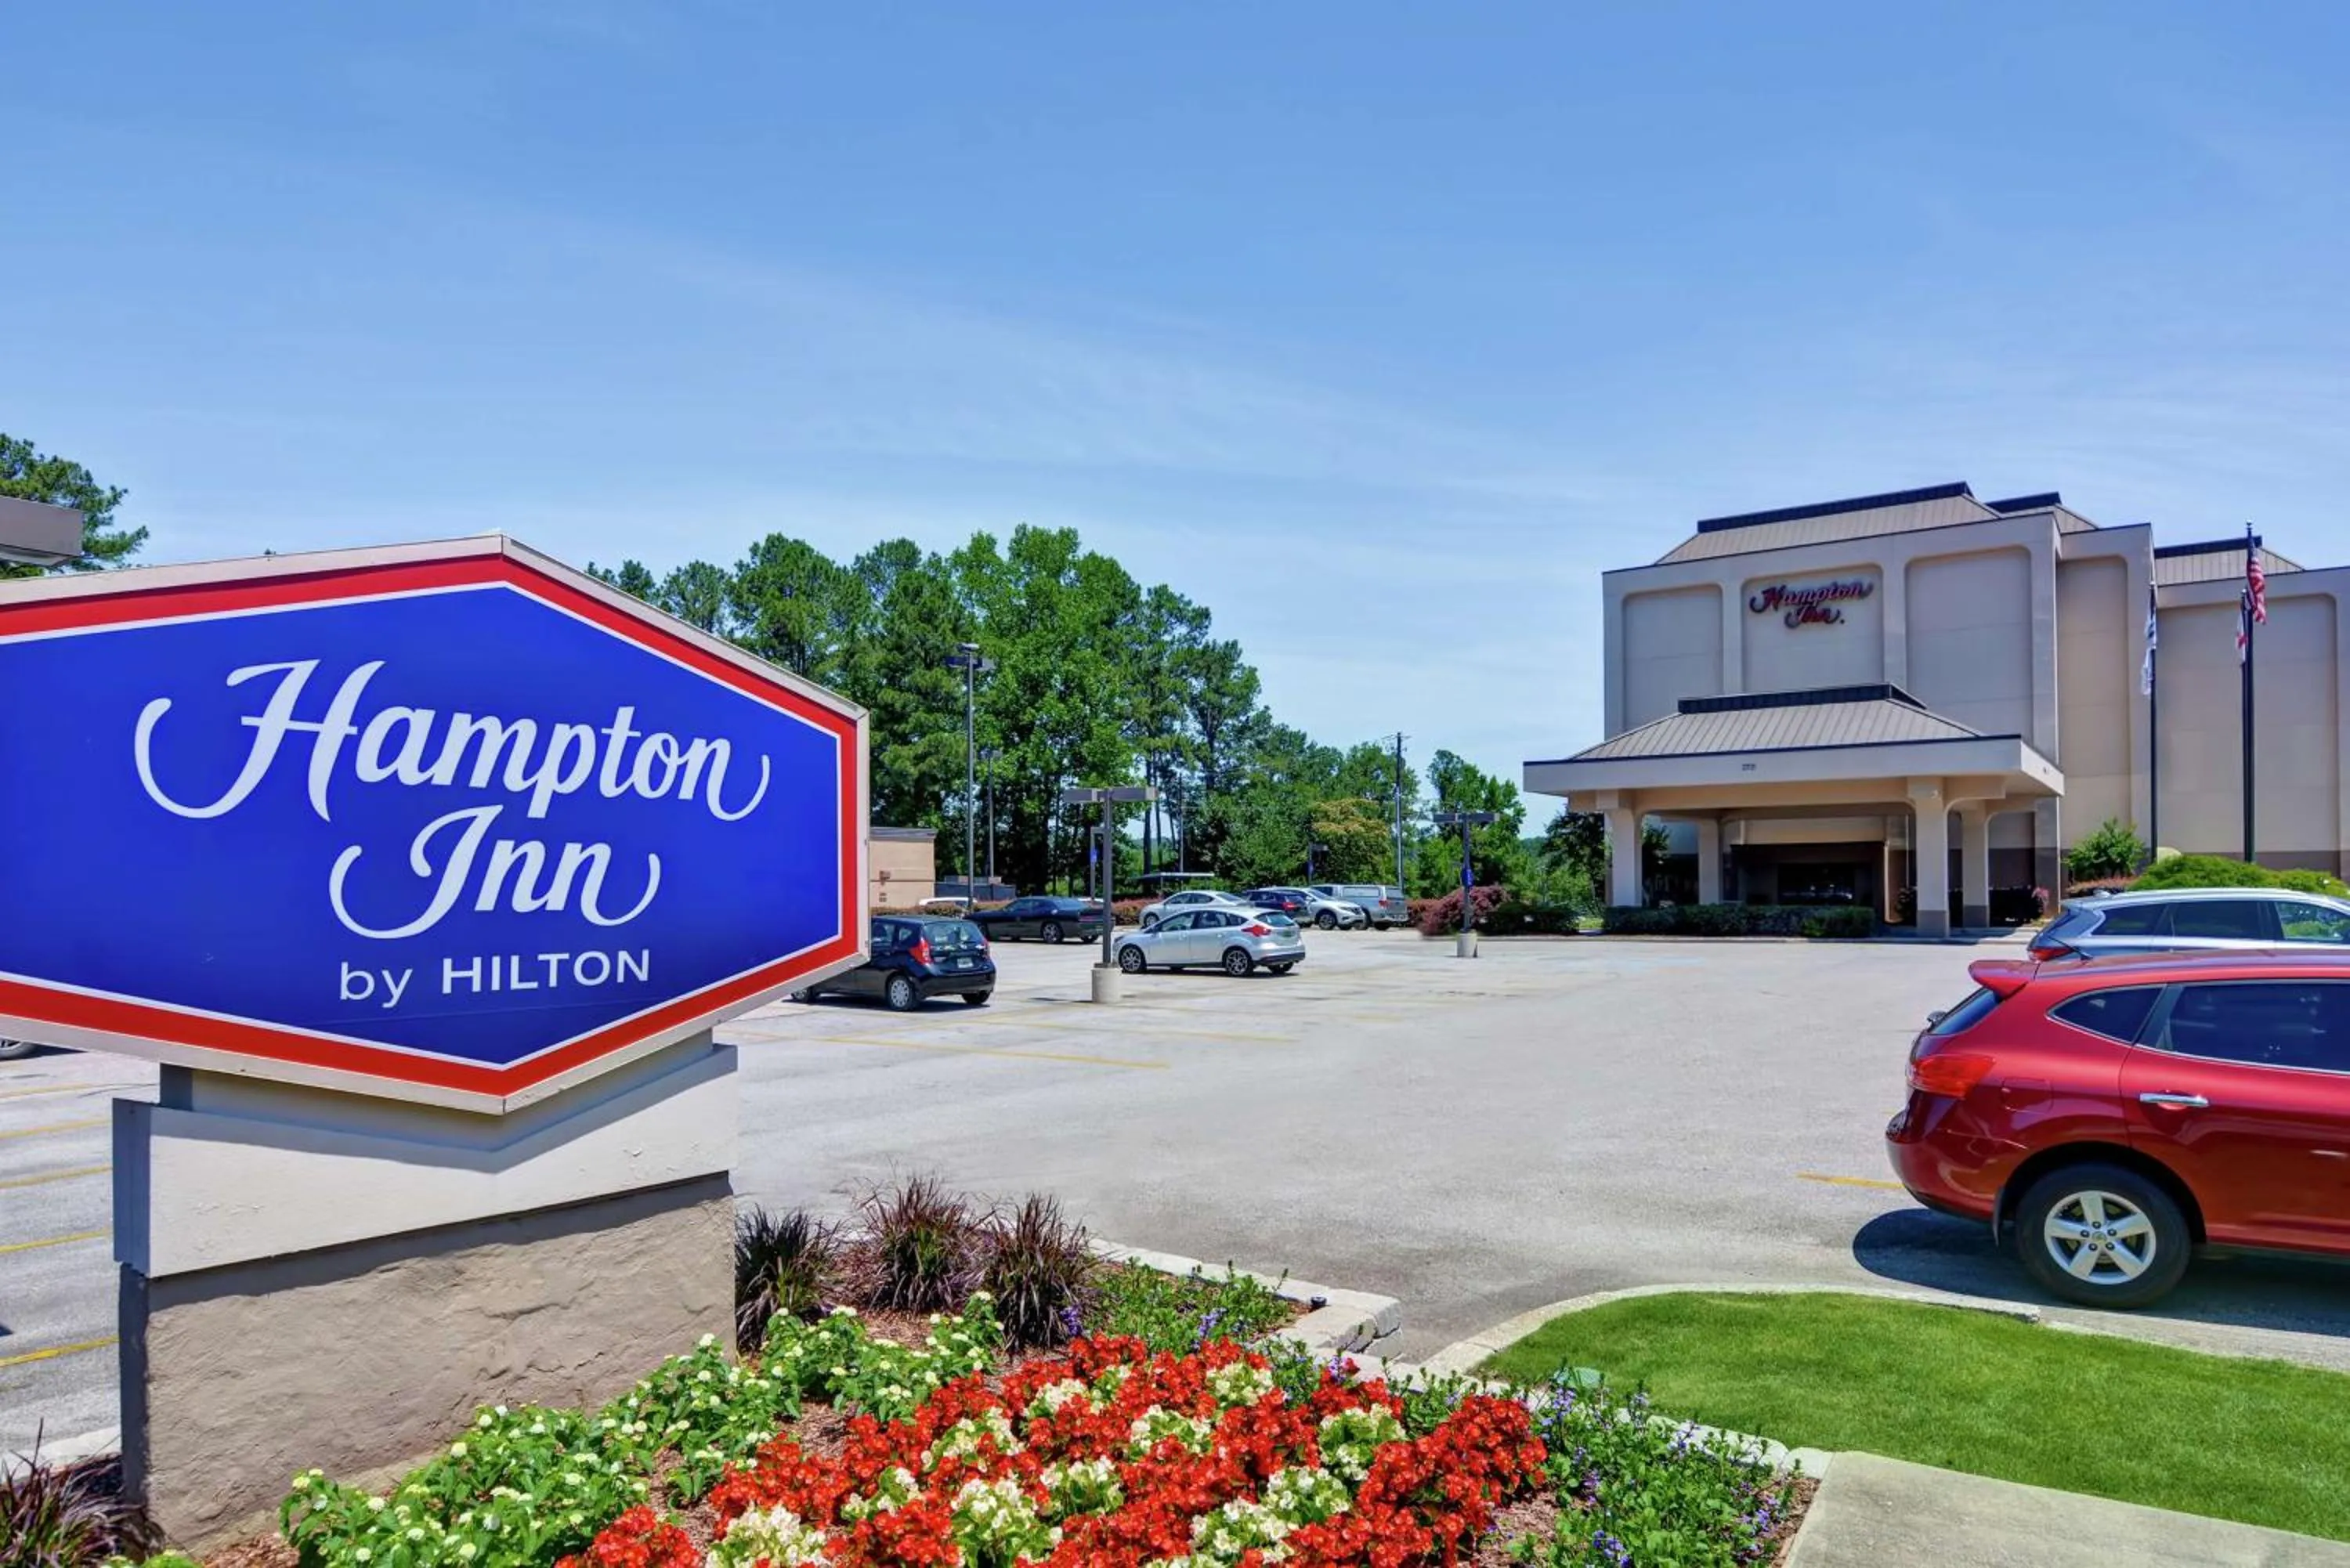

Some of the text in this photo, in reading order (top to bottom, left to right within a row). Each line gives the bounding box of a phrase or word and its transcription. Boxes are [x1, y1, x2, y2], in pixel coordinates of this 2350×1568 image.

[1749, 580, 1873, 613] Hampton
[134, 659, 770, 822] Hampton
[329, 804, 660, 939] Inn
[340, 949, 649, 1008] by HILTON
